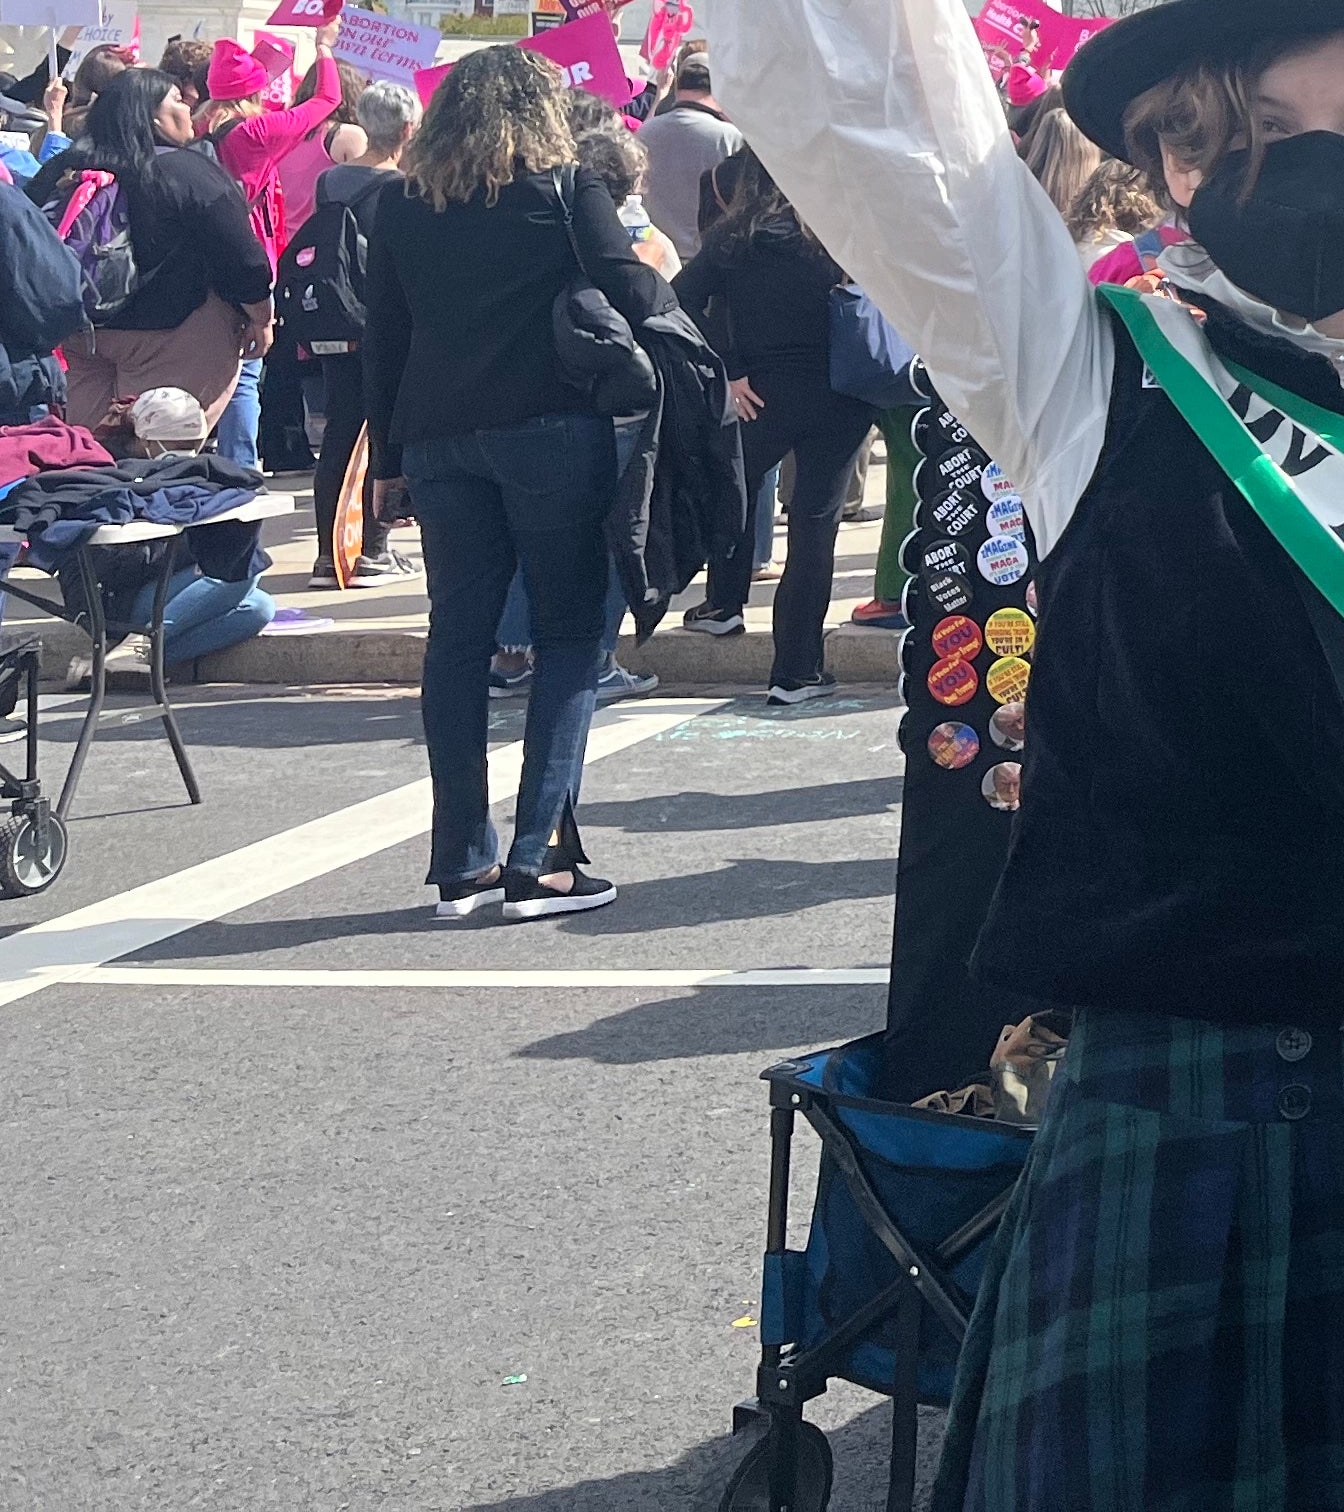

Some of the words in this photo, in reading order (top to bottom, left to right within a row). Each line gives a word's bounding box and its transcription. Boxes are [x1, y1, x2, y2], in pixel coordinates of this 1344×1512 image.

[939, 448, 972, 476] ABORT
[948, 464, 983, 489] COURT
[933, 490, 962, 522] ABORT
[947, 503, 978, 535] COURT
[924, 543, 957, 566] ABORT
[990, 556, 1019, 571] MAGA
[993, 569, 1021, 584] VOTE
[935, 585, 961, 602] Votes
